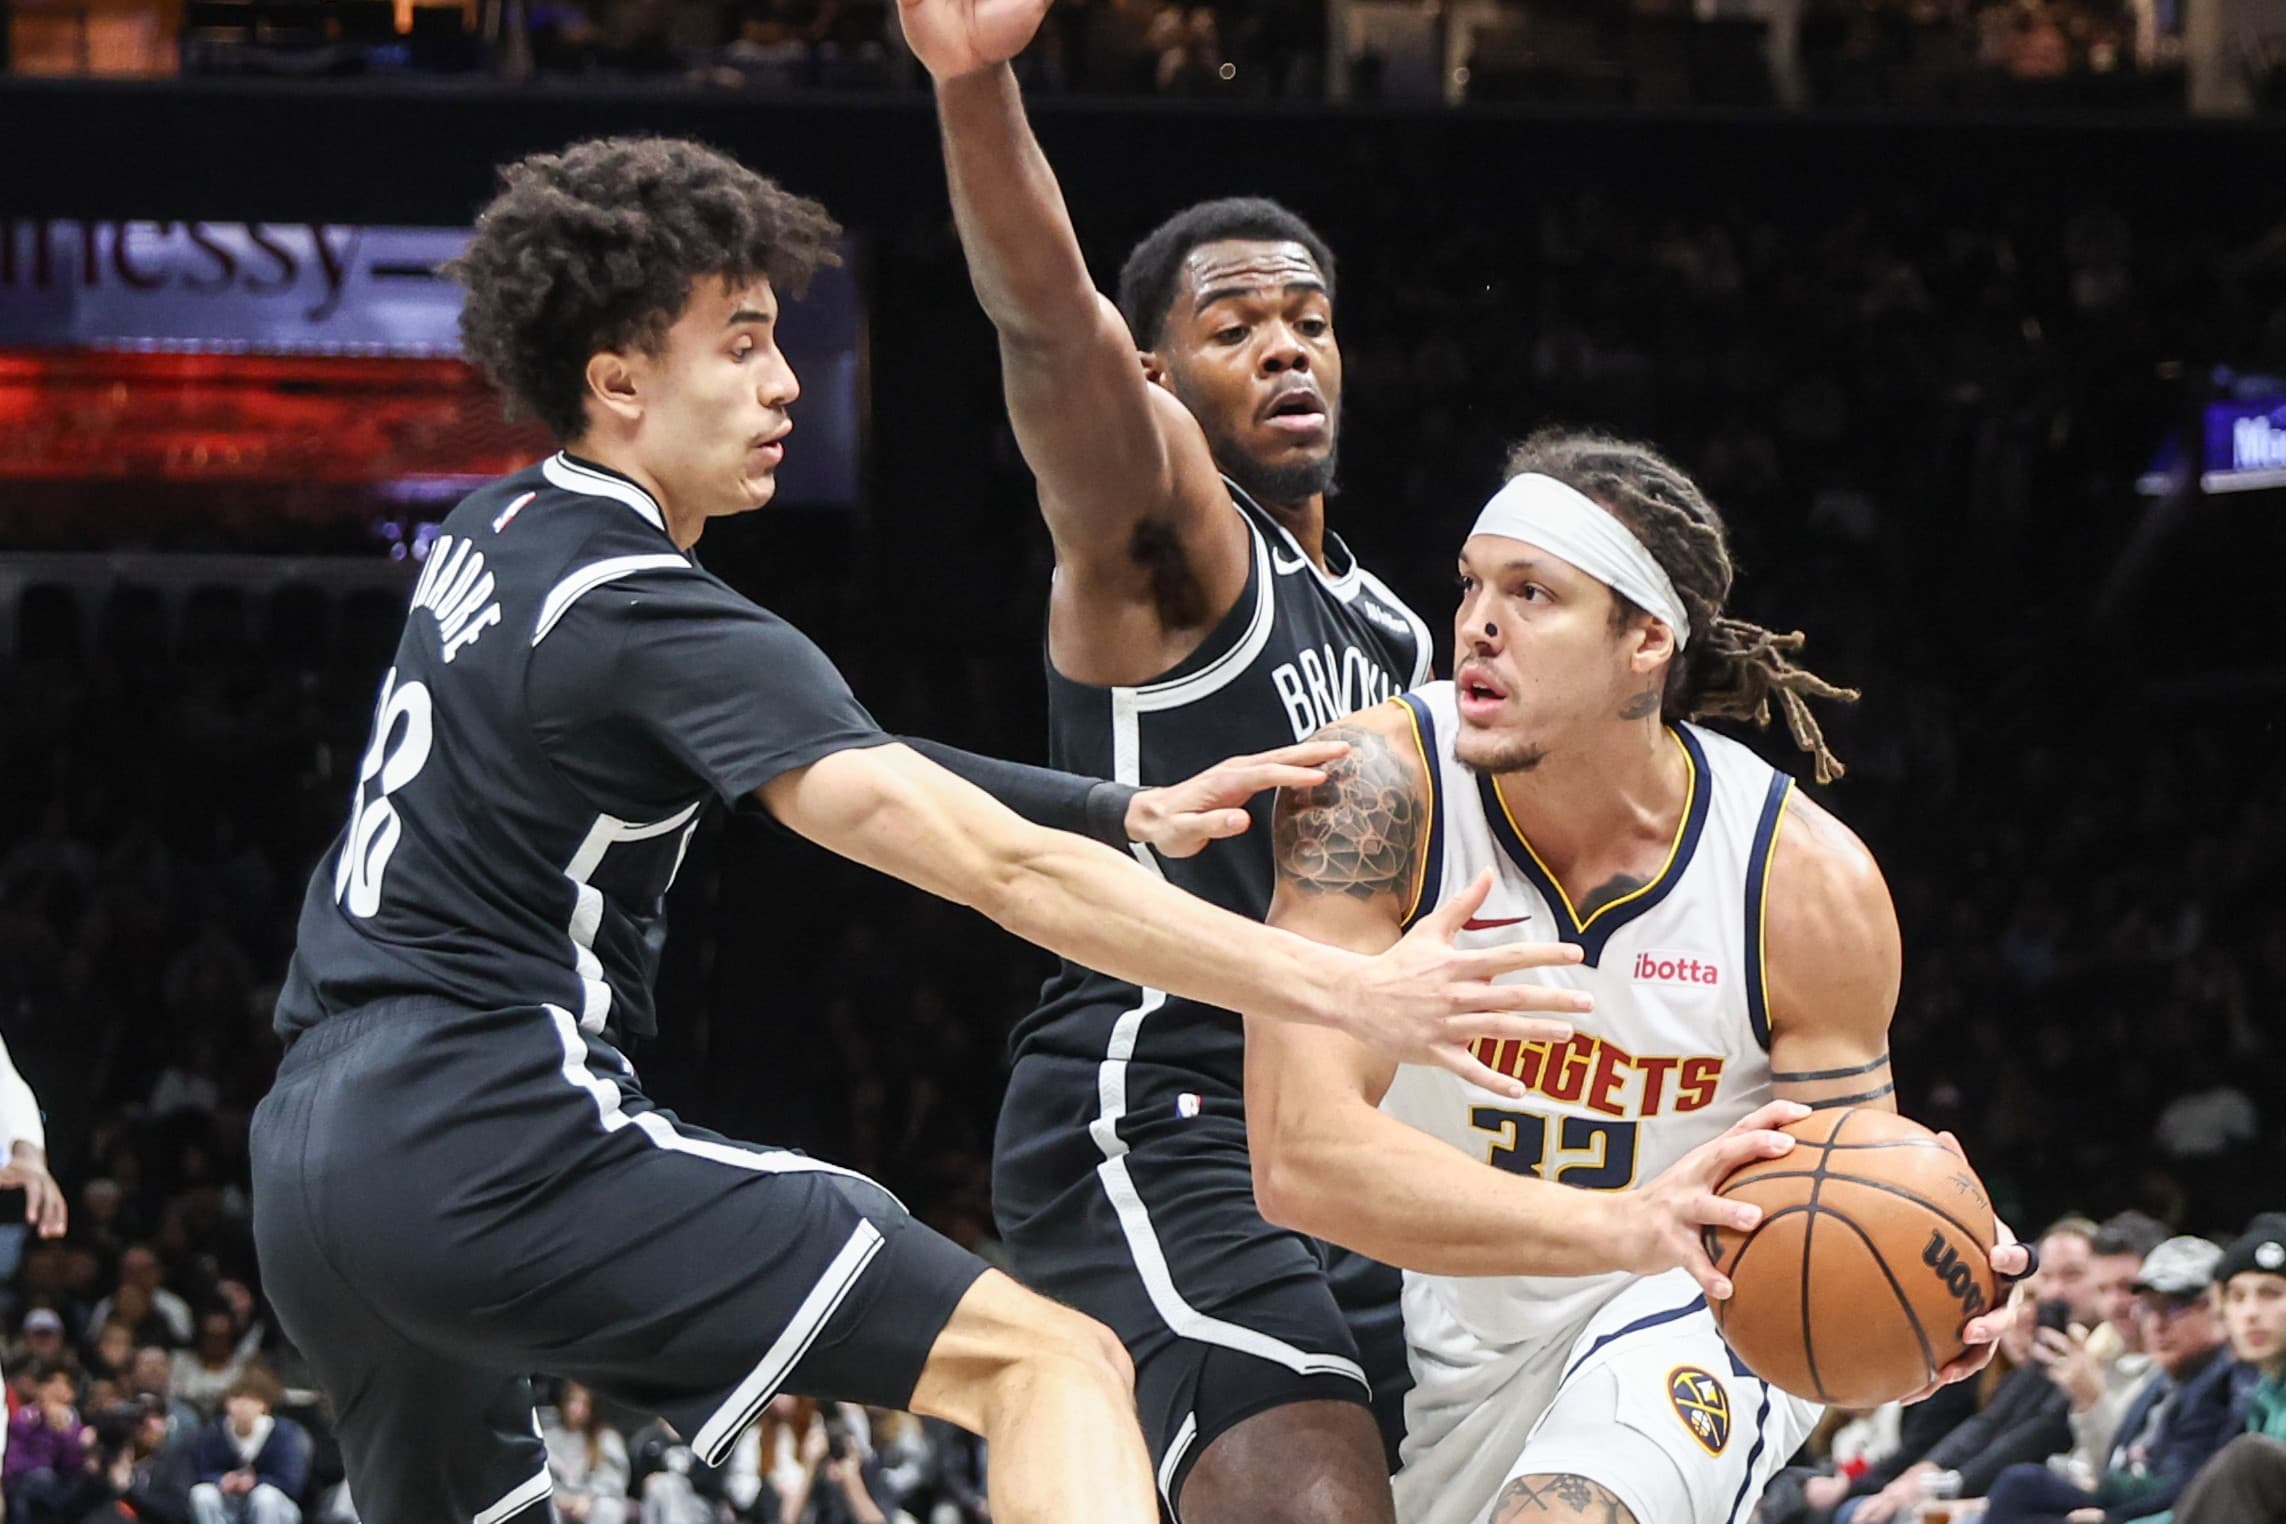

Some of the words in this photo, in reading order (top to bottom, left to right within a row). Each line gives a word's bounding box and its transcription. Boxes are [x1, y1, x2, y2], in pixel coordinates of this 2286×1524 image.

[409, 535, 501, 663] RAORE
[1633, 952, 1718, 985] ibotta
[1468, 1104, 1641, 1193] 32
